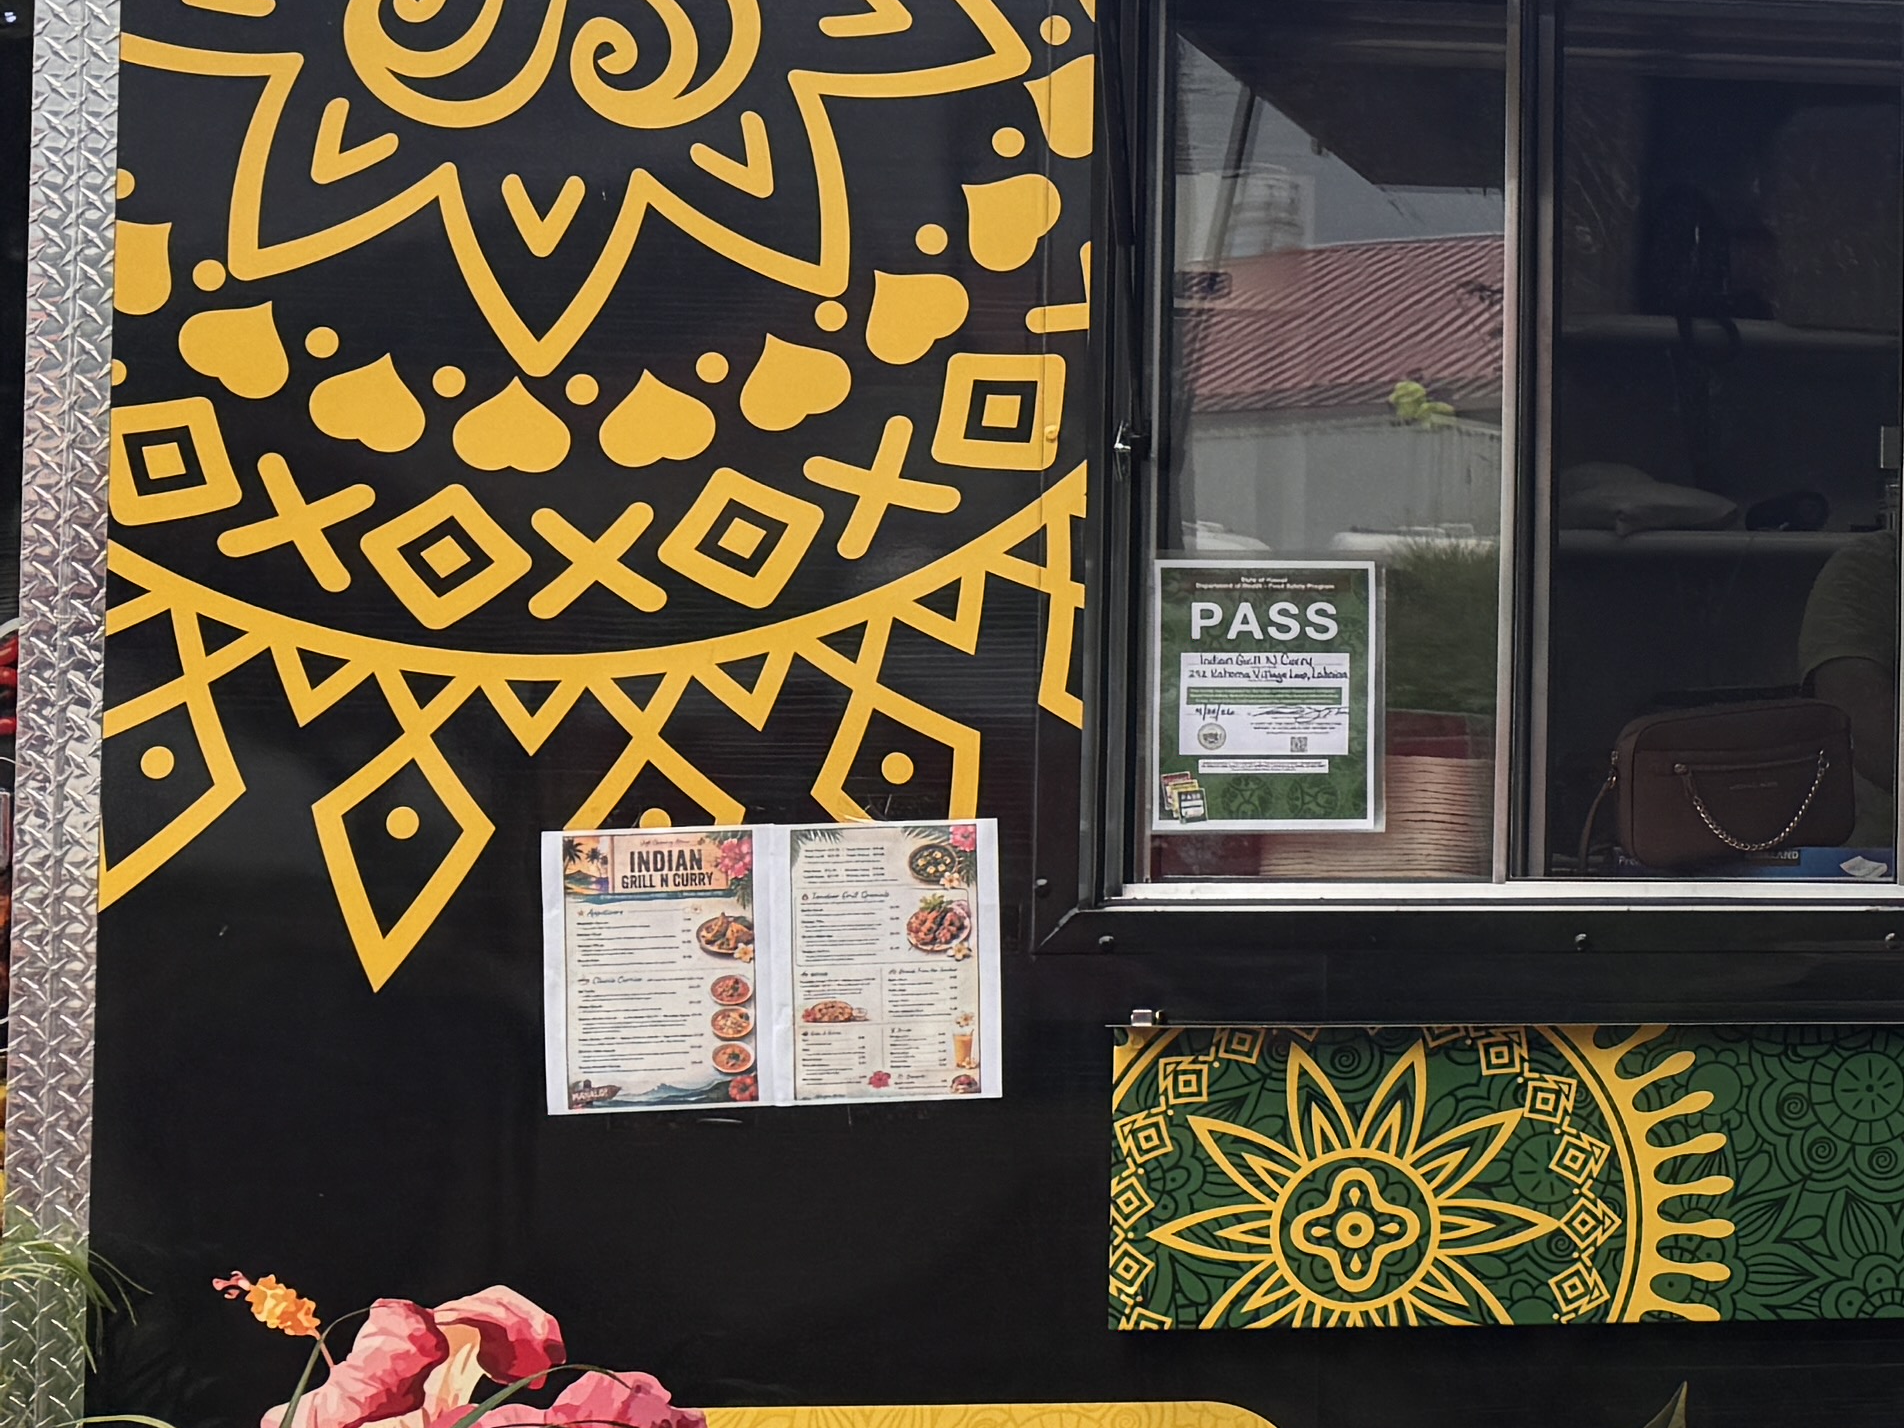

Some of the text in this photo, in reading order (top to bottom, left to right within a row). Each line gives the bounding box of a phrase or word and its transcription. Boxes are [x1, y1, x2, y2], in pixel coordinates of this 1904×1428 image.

[1191, 601, 1339, 641] PASS
[1200, 654, 1233, 665] Indian
[1265, 654, 1277, 666] N
[1280, 653, 1313, 667] Curry
[629, 848, 703, 873] INDIAN
[621, 872, 713, 889] GRILL N CURRY
